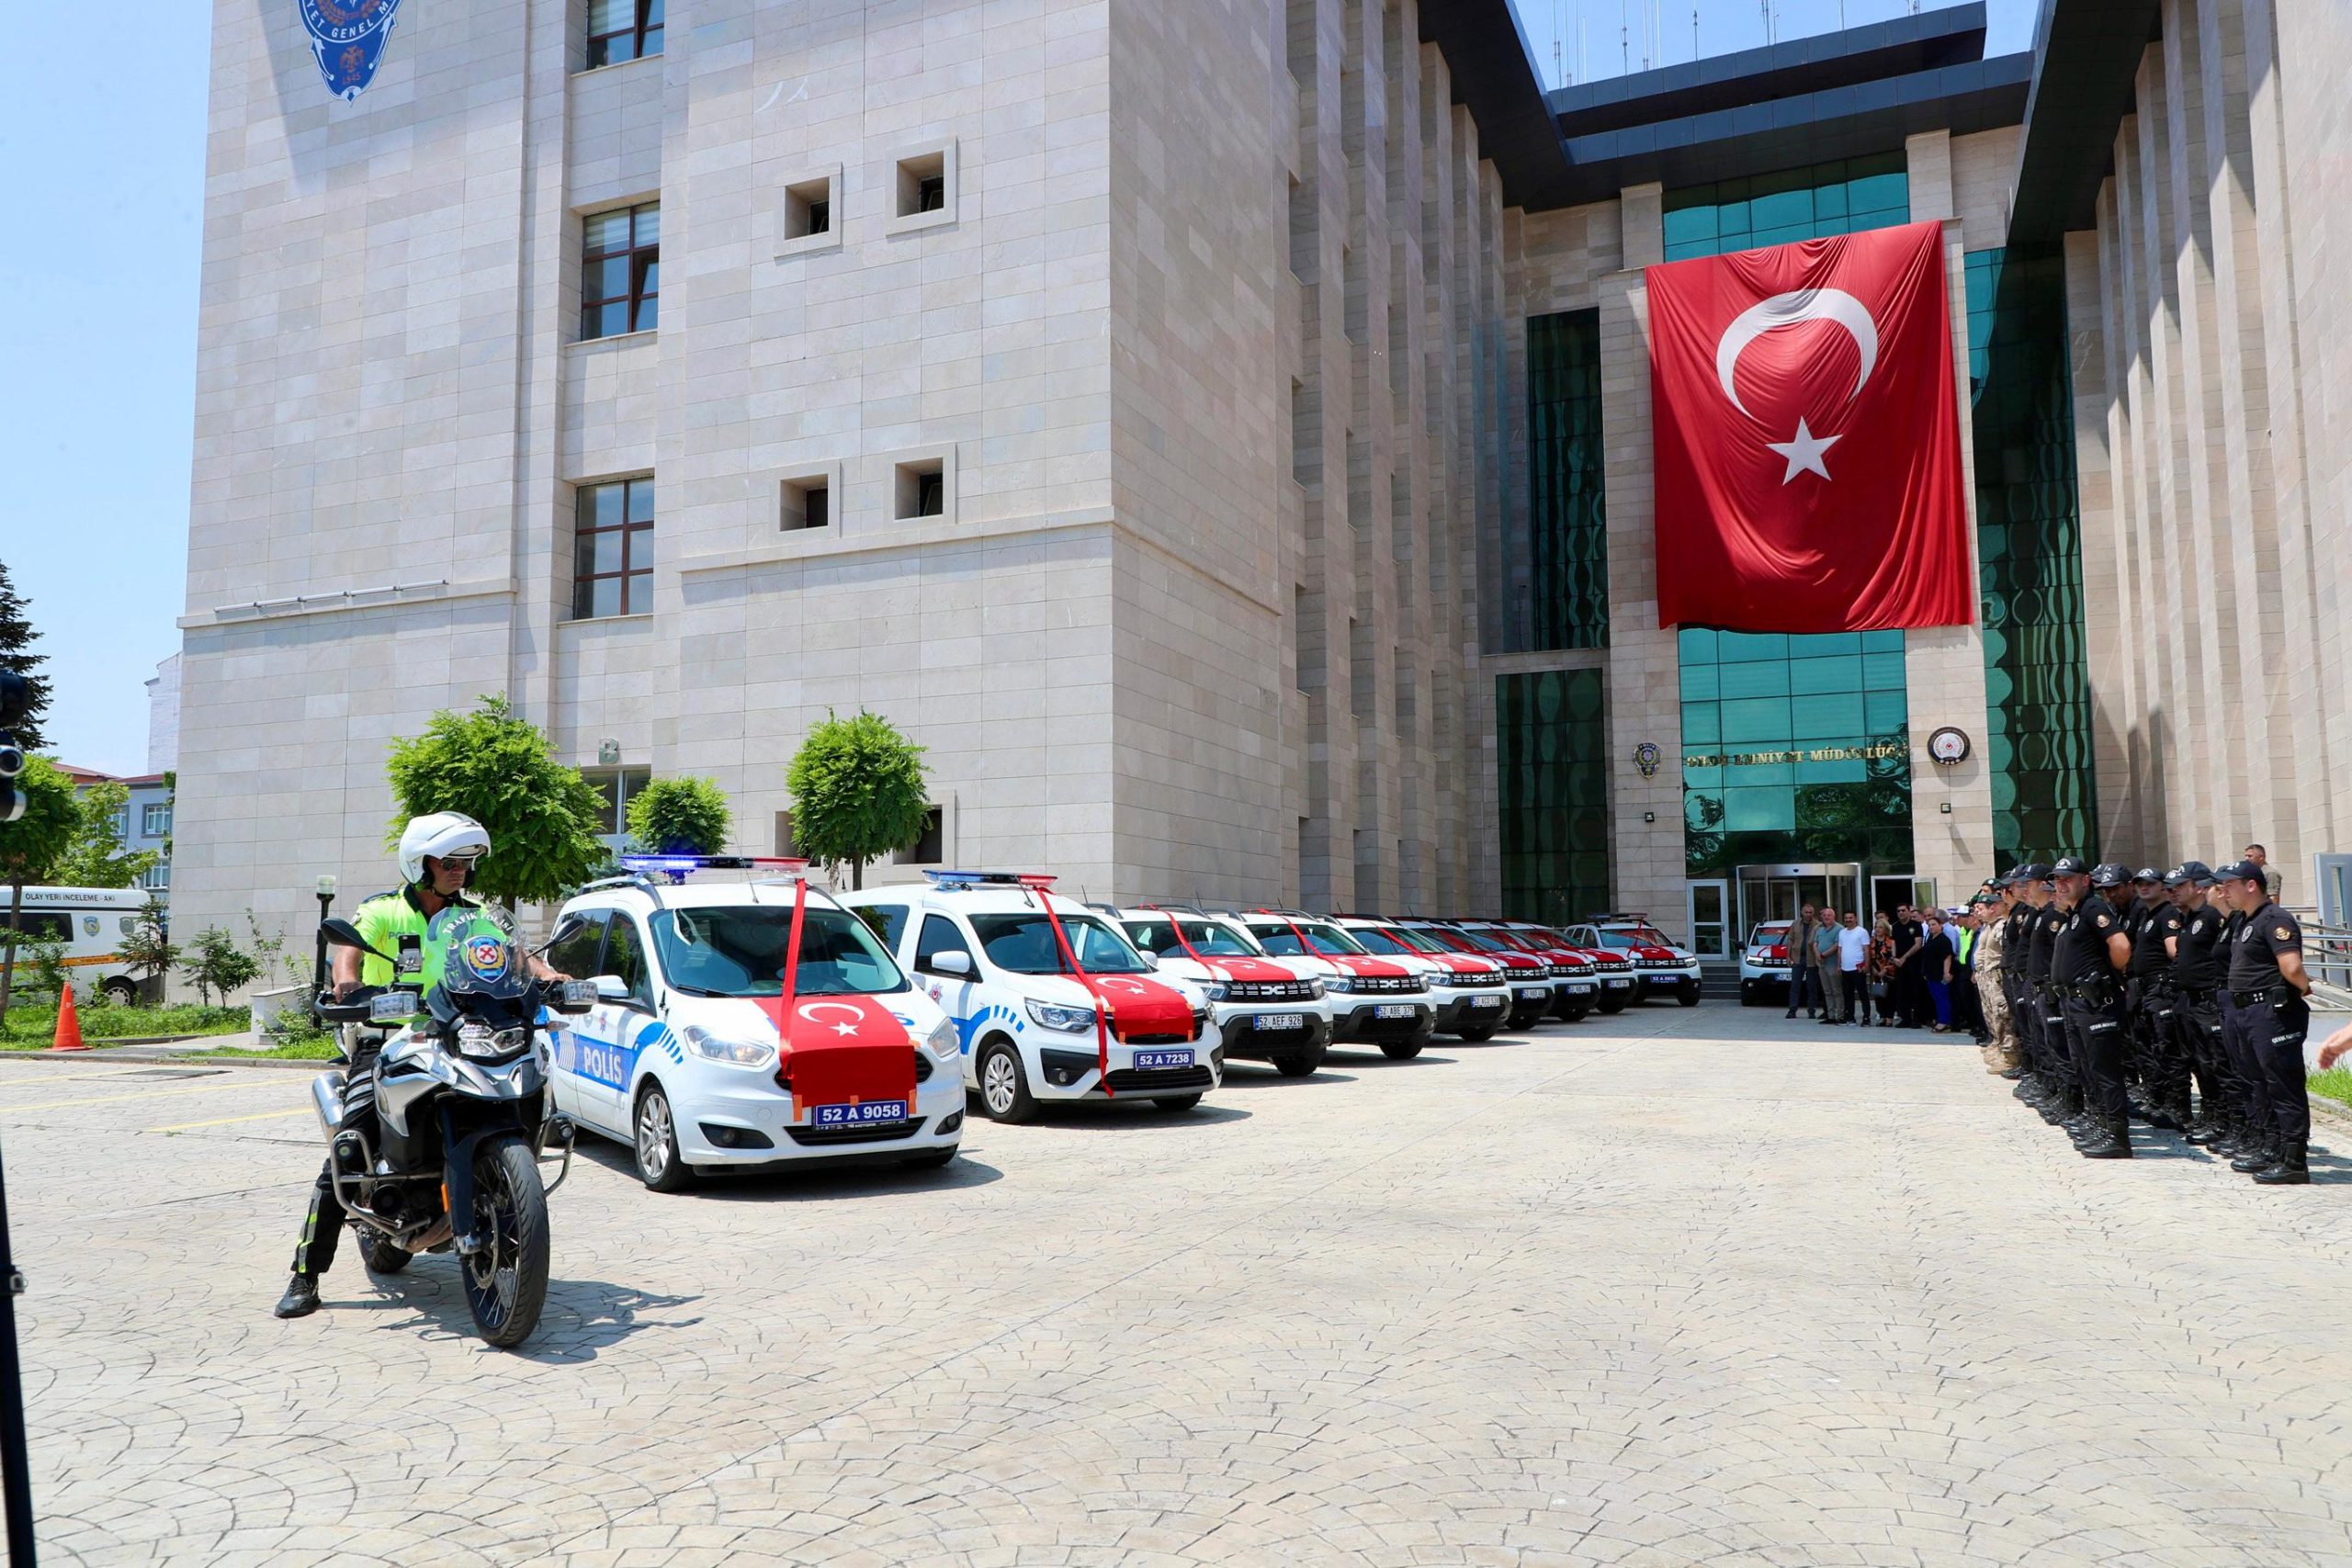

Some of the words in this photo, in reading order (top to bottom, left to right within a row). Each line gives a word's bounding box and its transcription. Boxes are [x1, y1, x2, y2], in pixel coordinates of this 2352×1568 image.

[332, 18, 374, 39] GENEL
[442, 911, 478, 934] TRAFİK
[1259, 1017, 1268, 1026] 52
[1272, 1016, 1285, 1026] AEF
[1288, 1015, 1302, 1025] 926
[583, 1044, 623, 1084] POLİS
[1139, 1055, 1153, 1066] 52
[1155, 1055, 1163, 1065] A
[1166, 1054, 1190, 1064] 7238
[822, 1109, 842, 1122] 52
[847, 1107, 859, 1120] A
[863, 1105, 901, 1119] 9058
